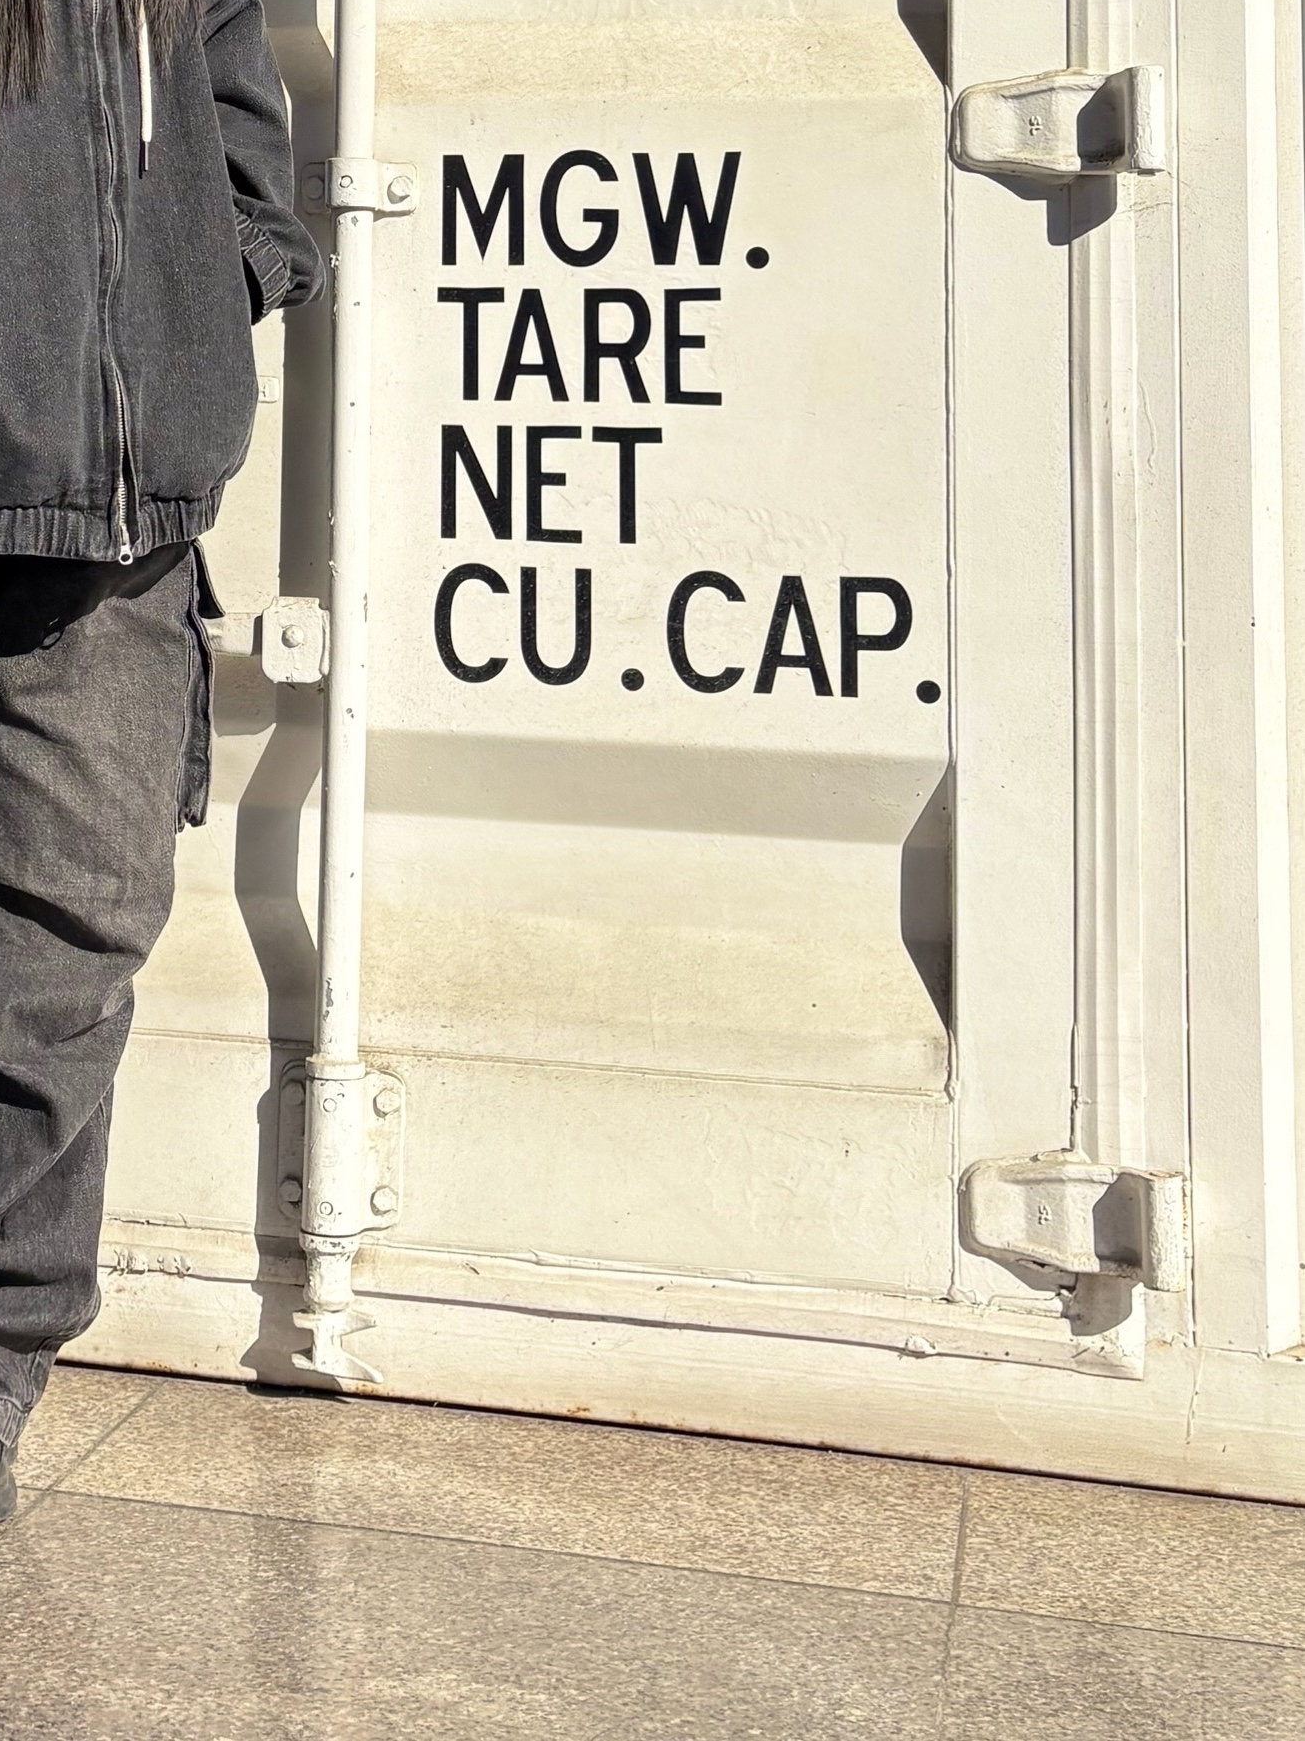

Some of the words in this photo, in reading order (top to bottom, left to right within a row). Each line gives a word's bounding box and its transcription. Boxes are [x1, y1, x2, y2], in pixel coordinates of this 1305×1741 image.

[441, 149, 770, 270] MGW.
[437, 286, 723, 406] TARE
[440, 424, 663, 545] NET
